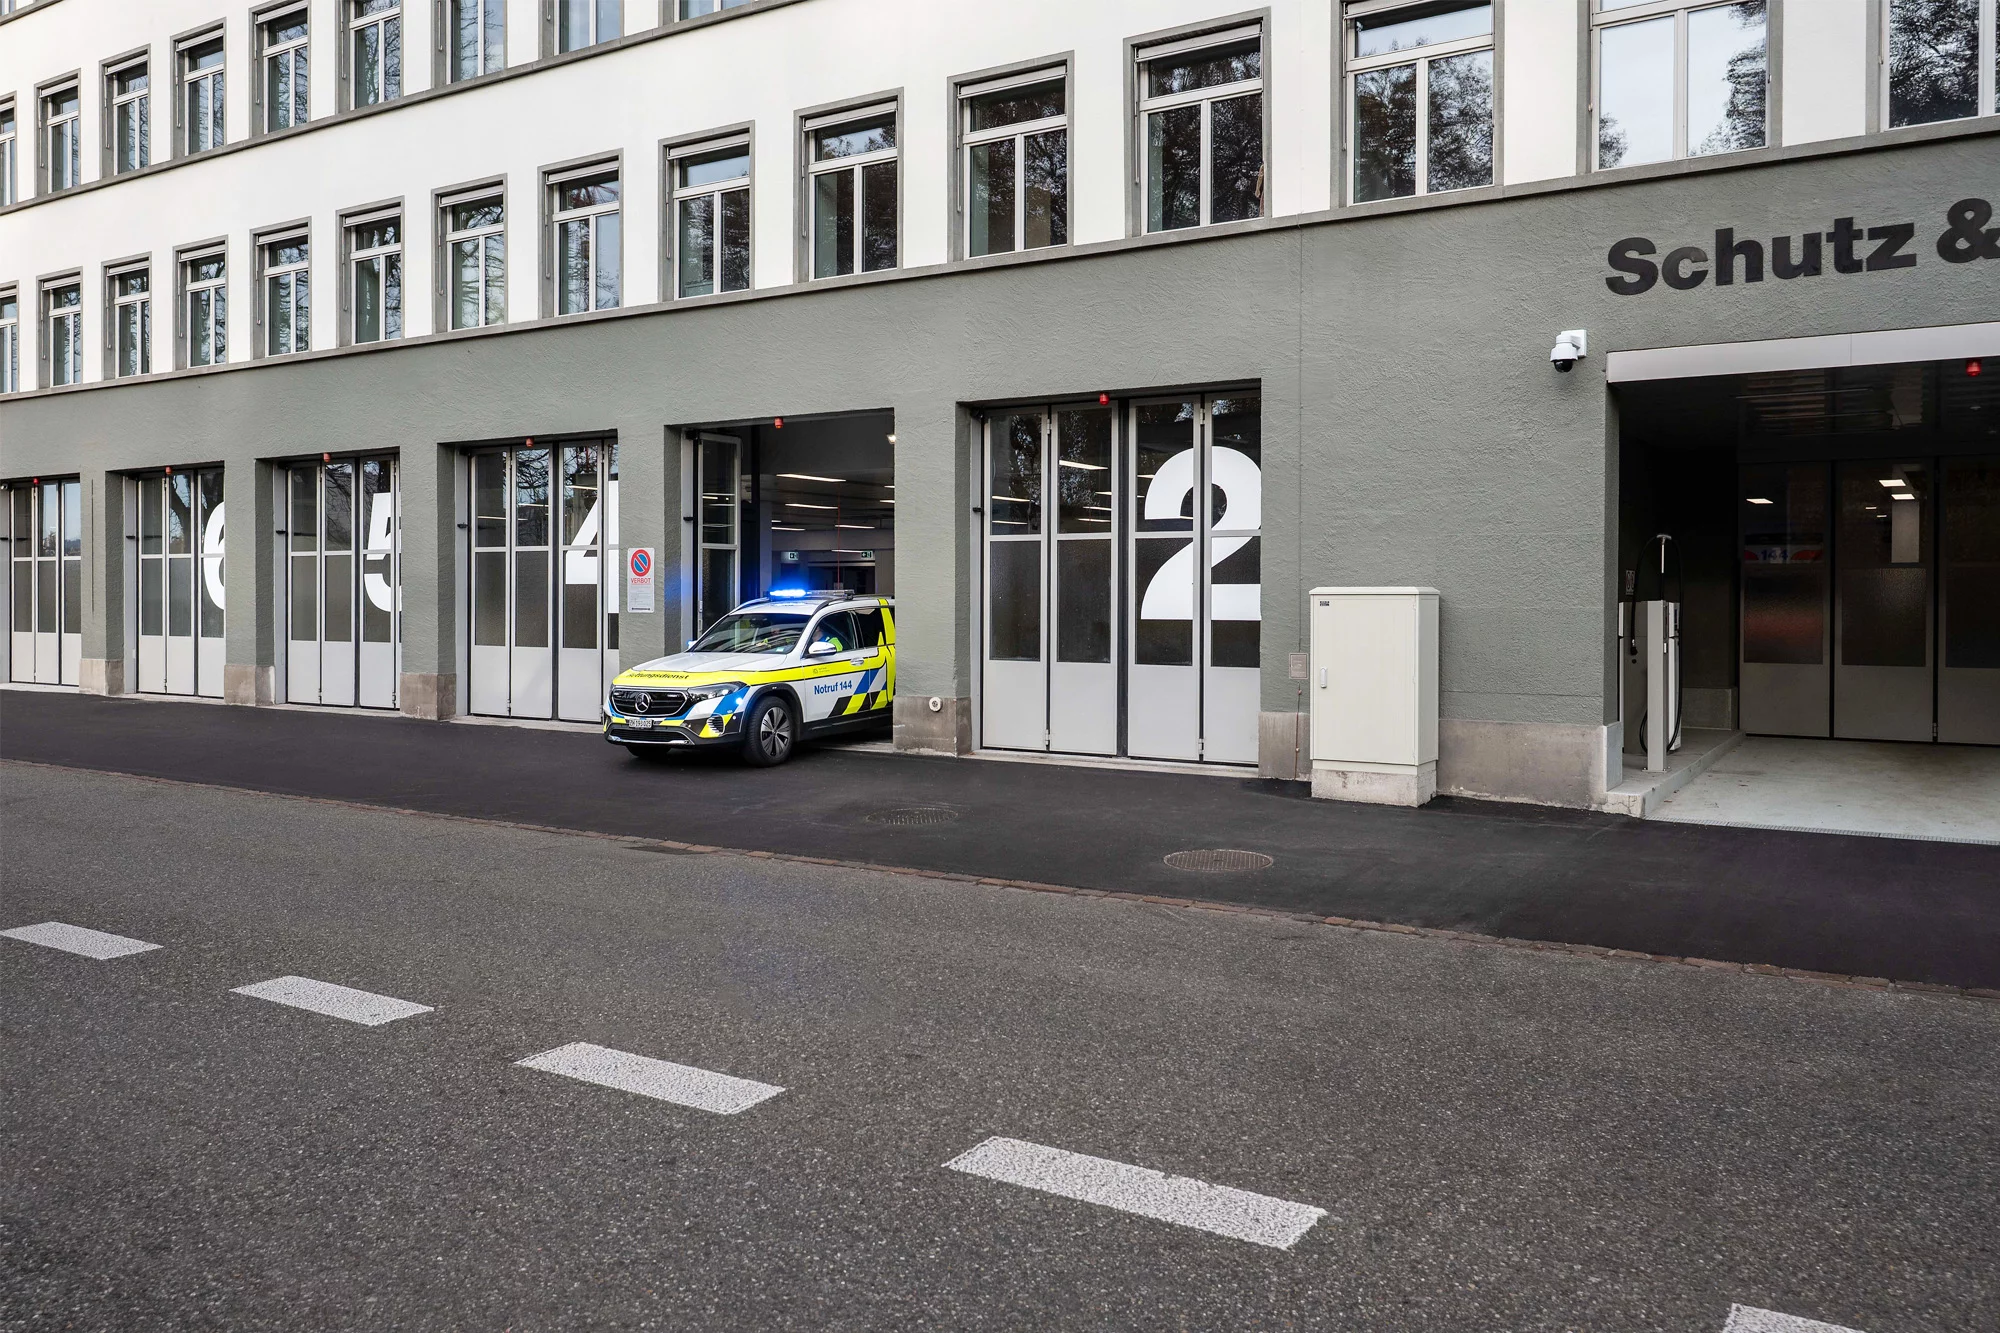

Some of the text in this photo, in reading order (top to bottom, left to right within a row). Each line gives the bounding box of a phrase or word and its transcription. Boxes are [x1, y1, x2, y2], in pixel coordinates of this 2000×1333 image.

[1605, 197, 2000, 296] Schutz &
[565, 480, 619, 613] 4
[1140, 446, 1262, 621] 2
[814, 680, 853, 695] Notruf 144
